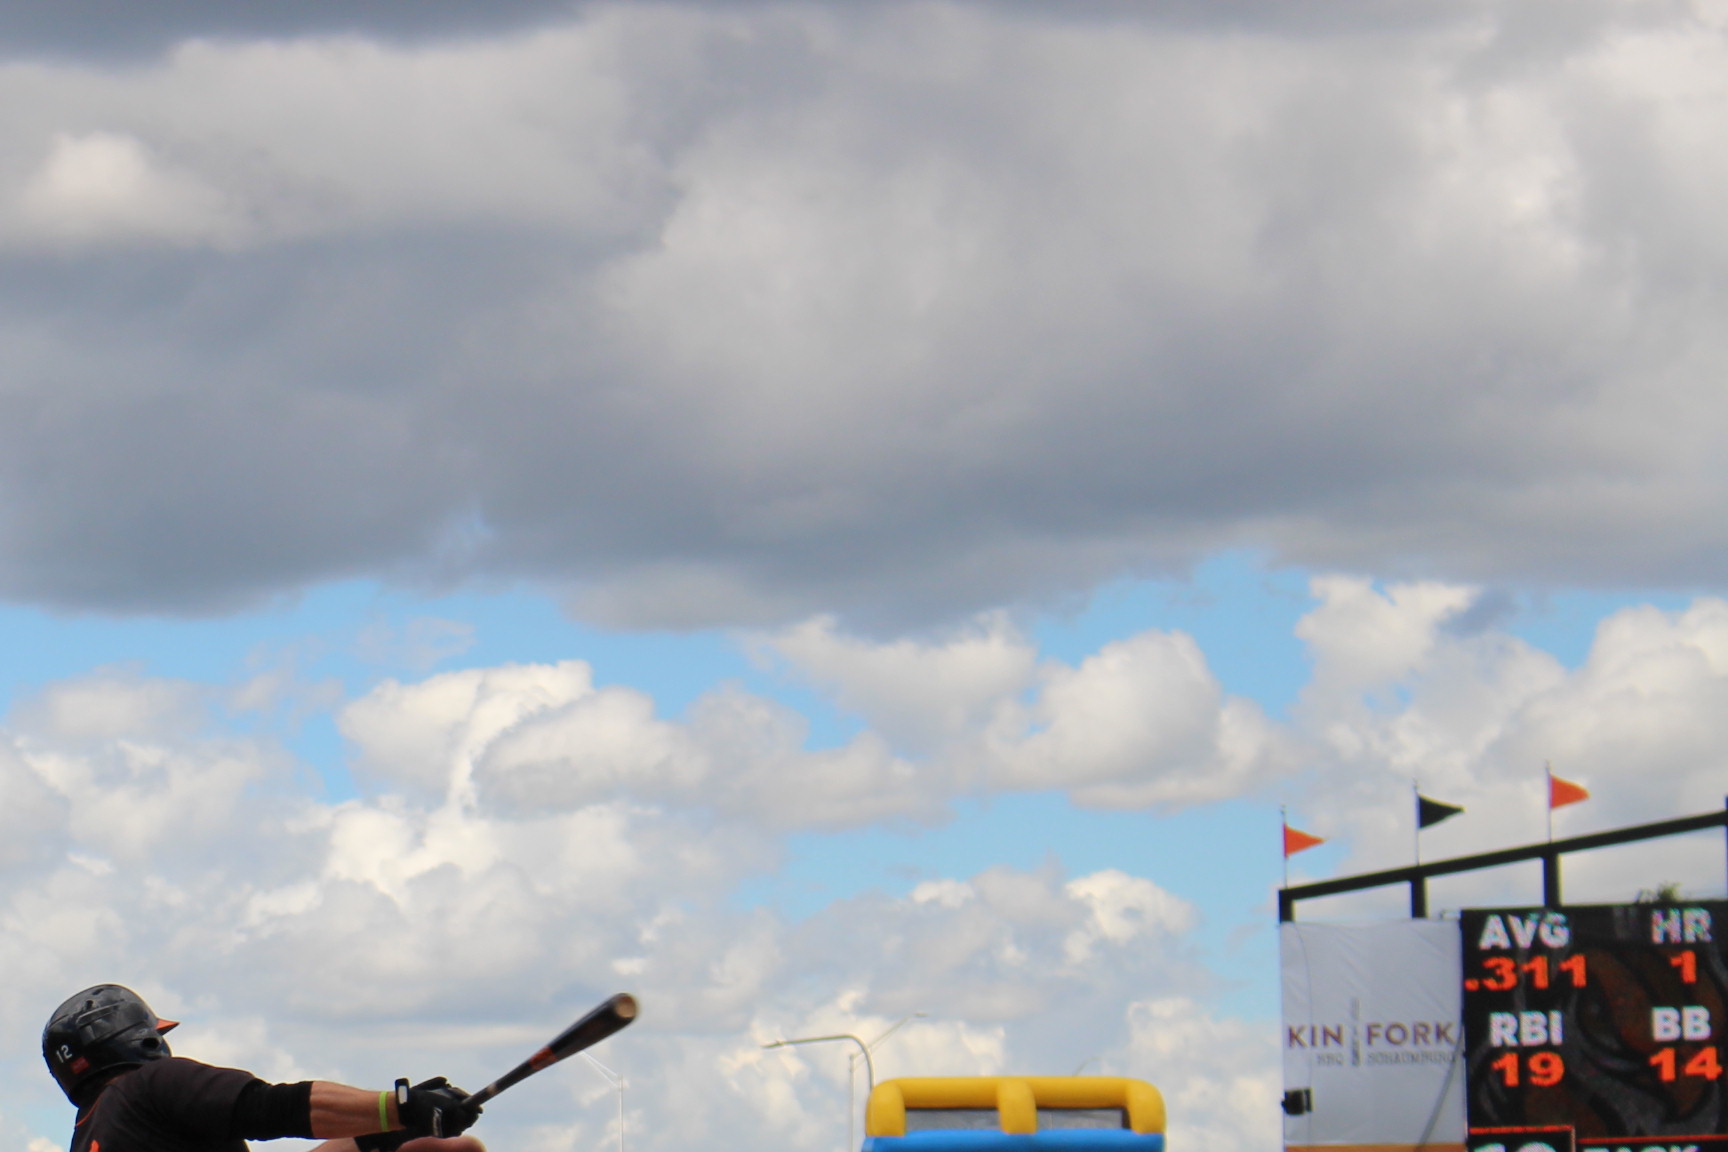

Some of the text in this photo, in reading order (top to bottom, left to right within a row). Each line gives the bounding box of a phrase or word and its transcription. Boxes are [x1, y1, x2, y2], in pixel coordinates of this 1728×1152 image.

[1478, 913, 1570, 950] AVG
[1651, 907, 1713, 944] HR
[1465, 953, 1587, 991] .311
[1670, 949, 1697, 984] 1
[1288, 1023, 1344, 1048] KIN
[1367, 1021, 1456, 1046] FORK
[1489, 1010, 1564, 1047] RBI
[1651, 1004, 1712, 1042] BB
[56, 1044, 73, 1063] 12
[1492, 1052, 1565, 1087] 19
[1650, 1046, 1722, 1083] 14
